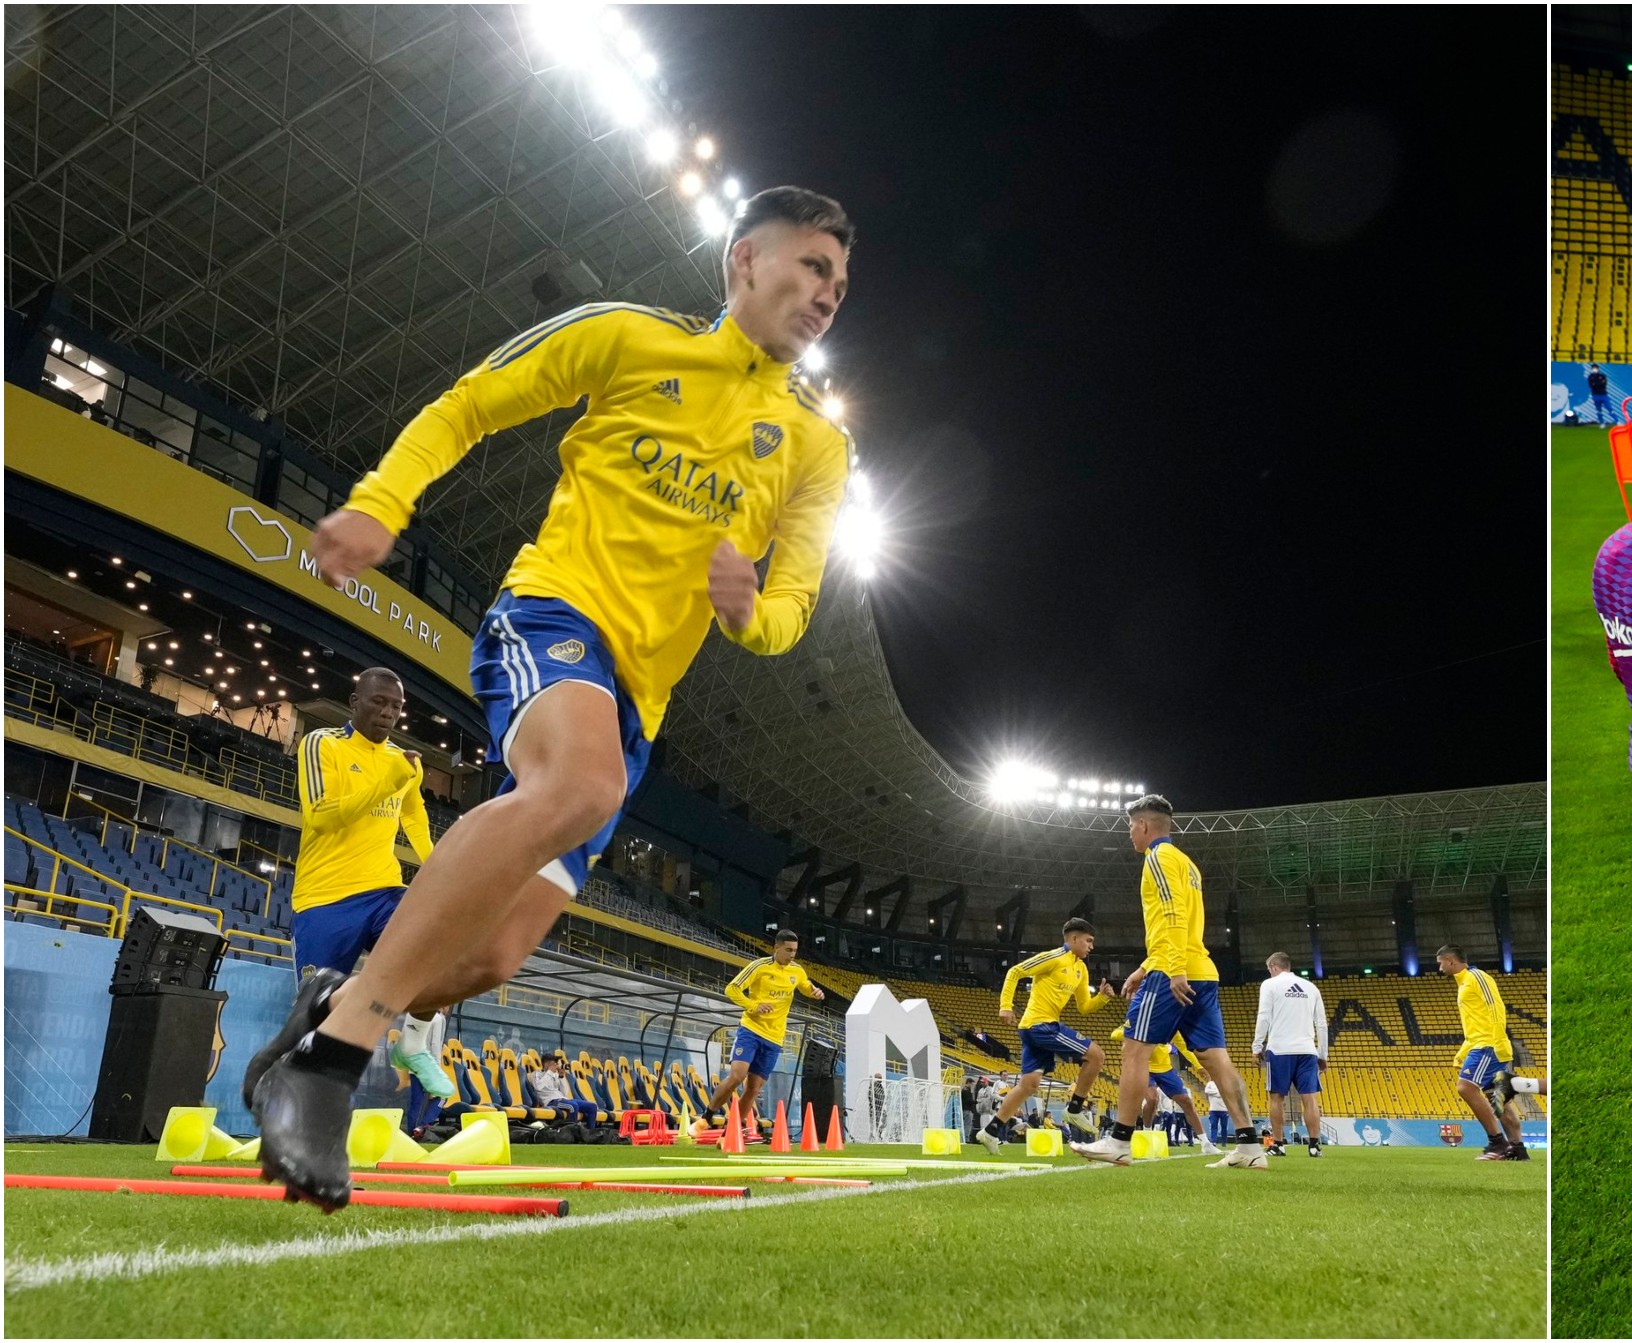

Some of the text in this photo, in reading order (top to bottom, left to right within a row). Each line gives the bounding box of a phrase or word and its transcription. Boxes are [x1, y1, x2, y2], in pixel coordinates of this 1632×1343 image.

[631, 435, 744, 512] QATAR
[646, 478, 731, 528] AIRWAYS
[389, 601, 442, 653] PARK
